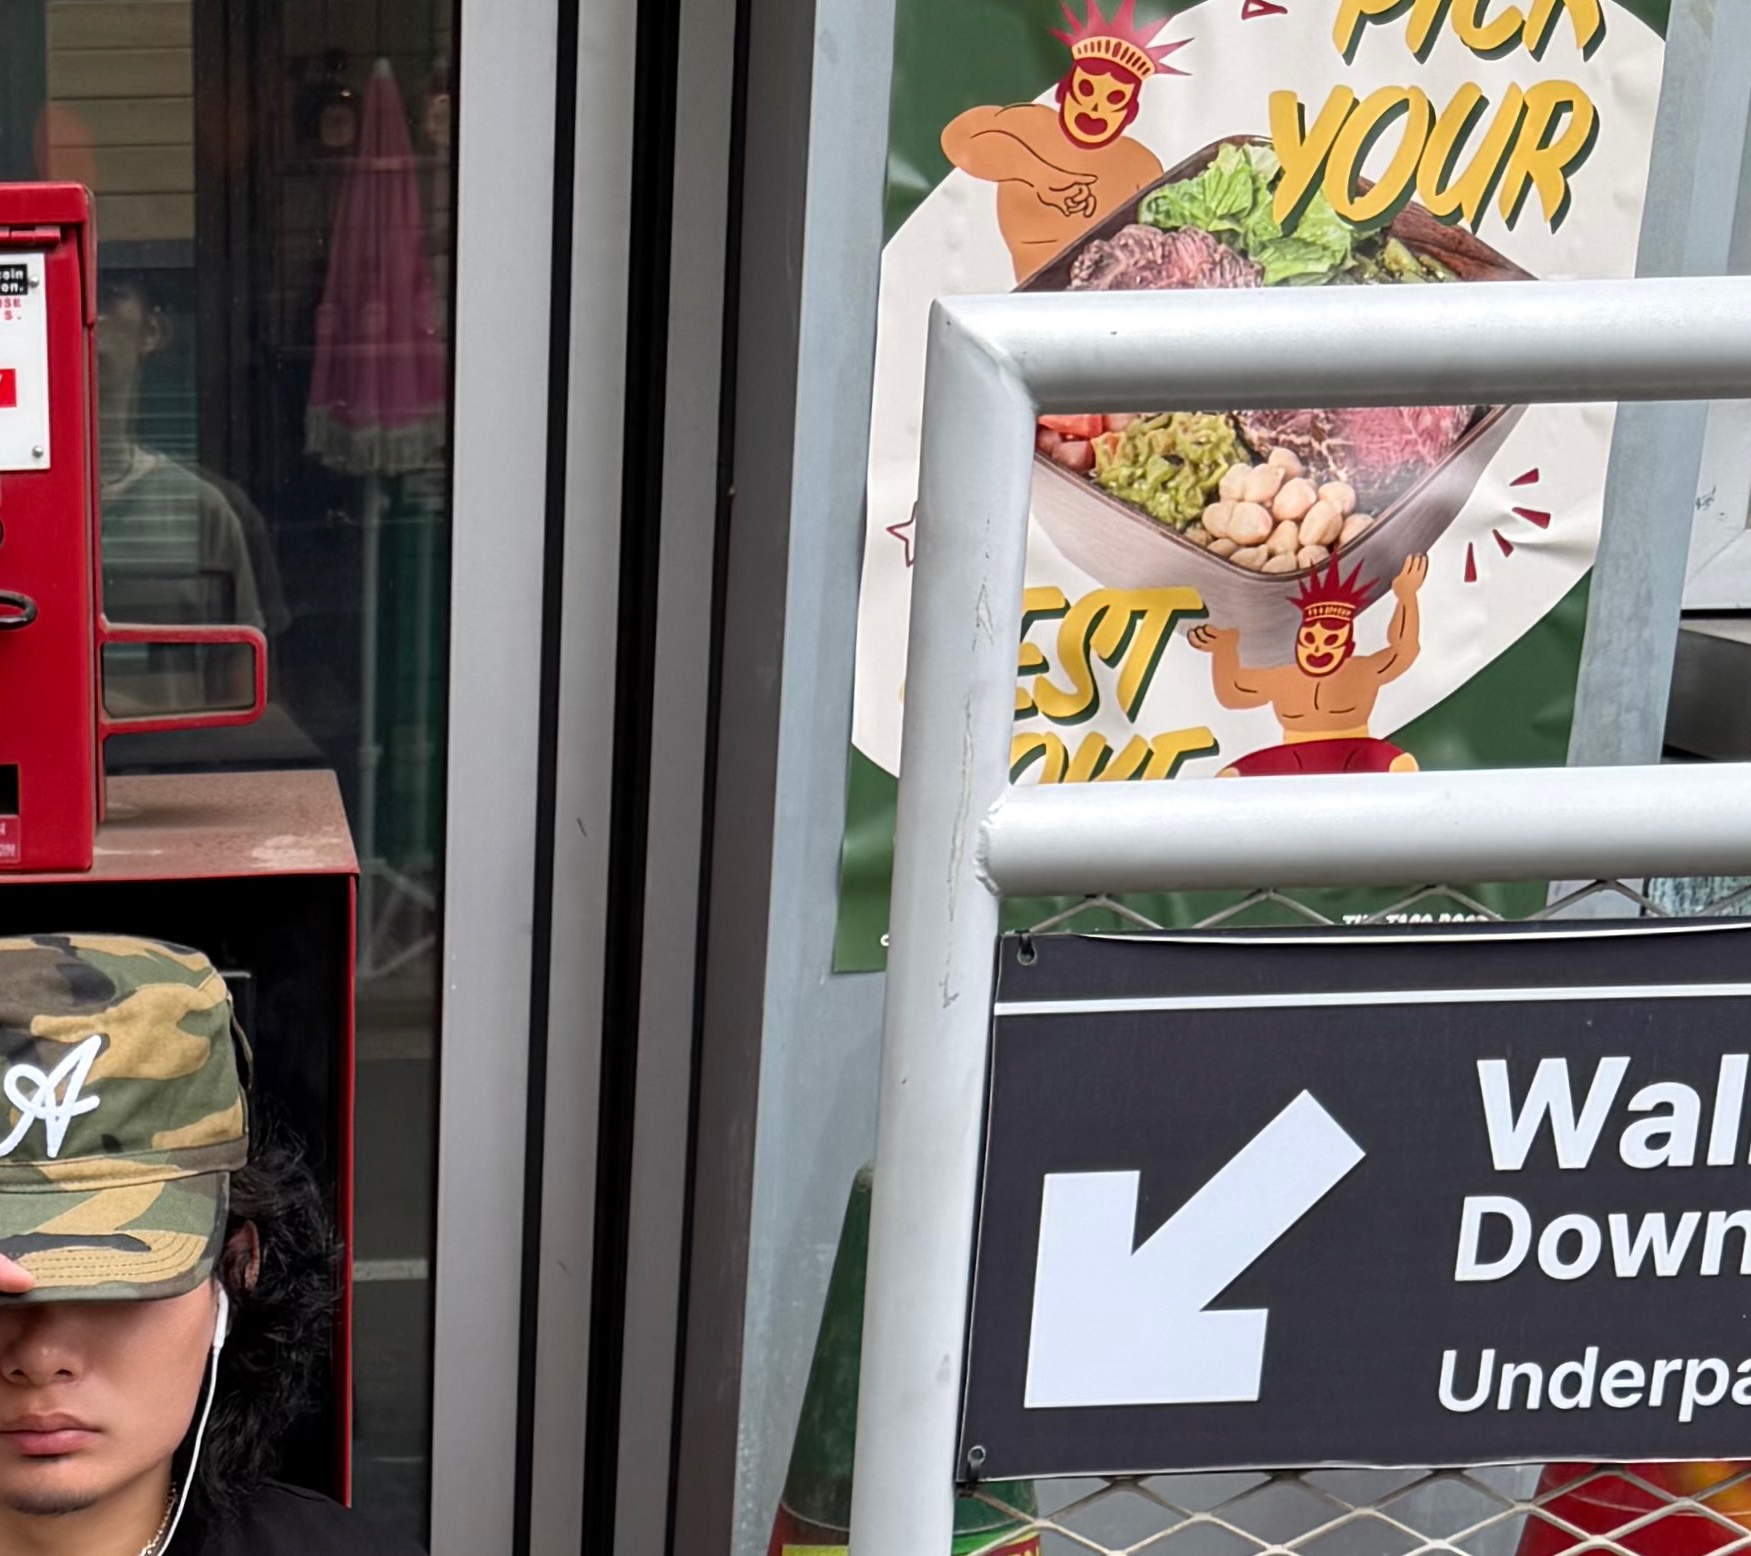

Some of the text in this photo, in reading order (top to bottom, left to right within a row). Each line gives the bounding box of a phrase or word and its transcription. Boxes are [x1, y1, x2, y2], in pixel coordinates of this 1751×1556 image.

[1268, 81, 1601, 234] YOUR
[1013, 586, 1209, 724] EST
[1477, 1053, 1751, 1171] Wal
[1454, 1195, 1751, 1281] Down
